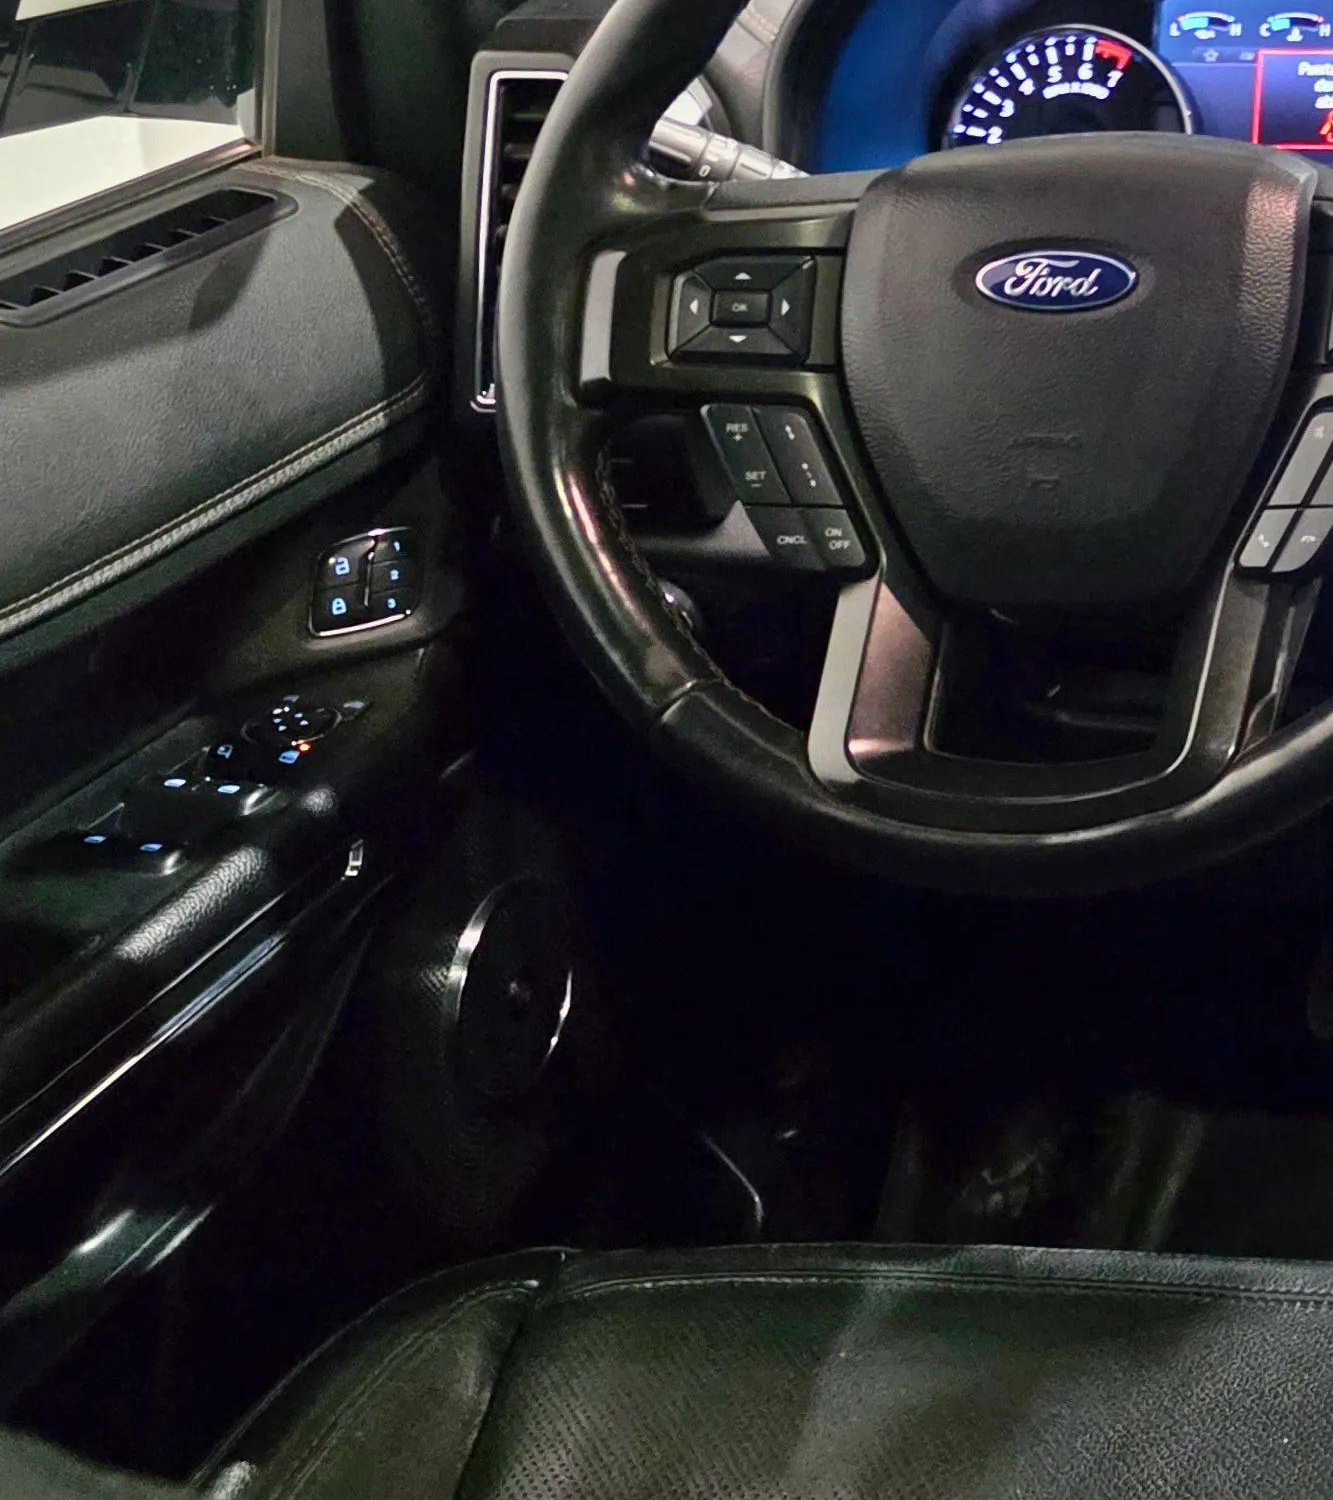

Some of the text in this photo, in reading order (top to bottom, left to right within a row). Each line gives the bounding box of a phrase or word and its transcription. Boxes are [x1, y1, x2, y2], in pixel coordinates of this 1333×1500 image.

[1229, 23, 1242, 37] H
[1259, 23, 1270, 37] C
[1319, 23, 1331, 37] H
[1047, 65, 1062, 83] 5
[1078, 62, 1093, 80] 6
[1107, 70, 1124, 88] 7
[1018, 78, 1035, 95] 4
[999, 99, 1014, 117] 3
[986, 126, 1002, 144] 2
[1004, 257, 1101, 297] Ford
[732, 303, 748, 312] OK
[726, 423, 748, 433] RES
[745, 471, 766, 481] SET
[825, 527, 842, 537] ON
[777, 535, 808, 545] CNCL
[829, 540, 850, 550] OFF
